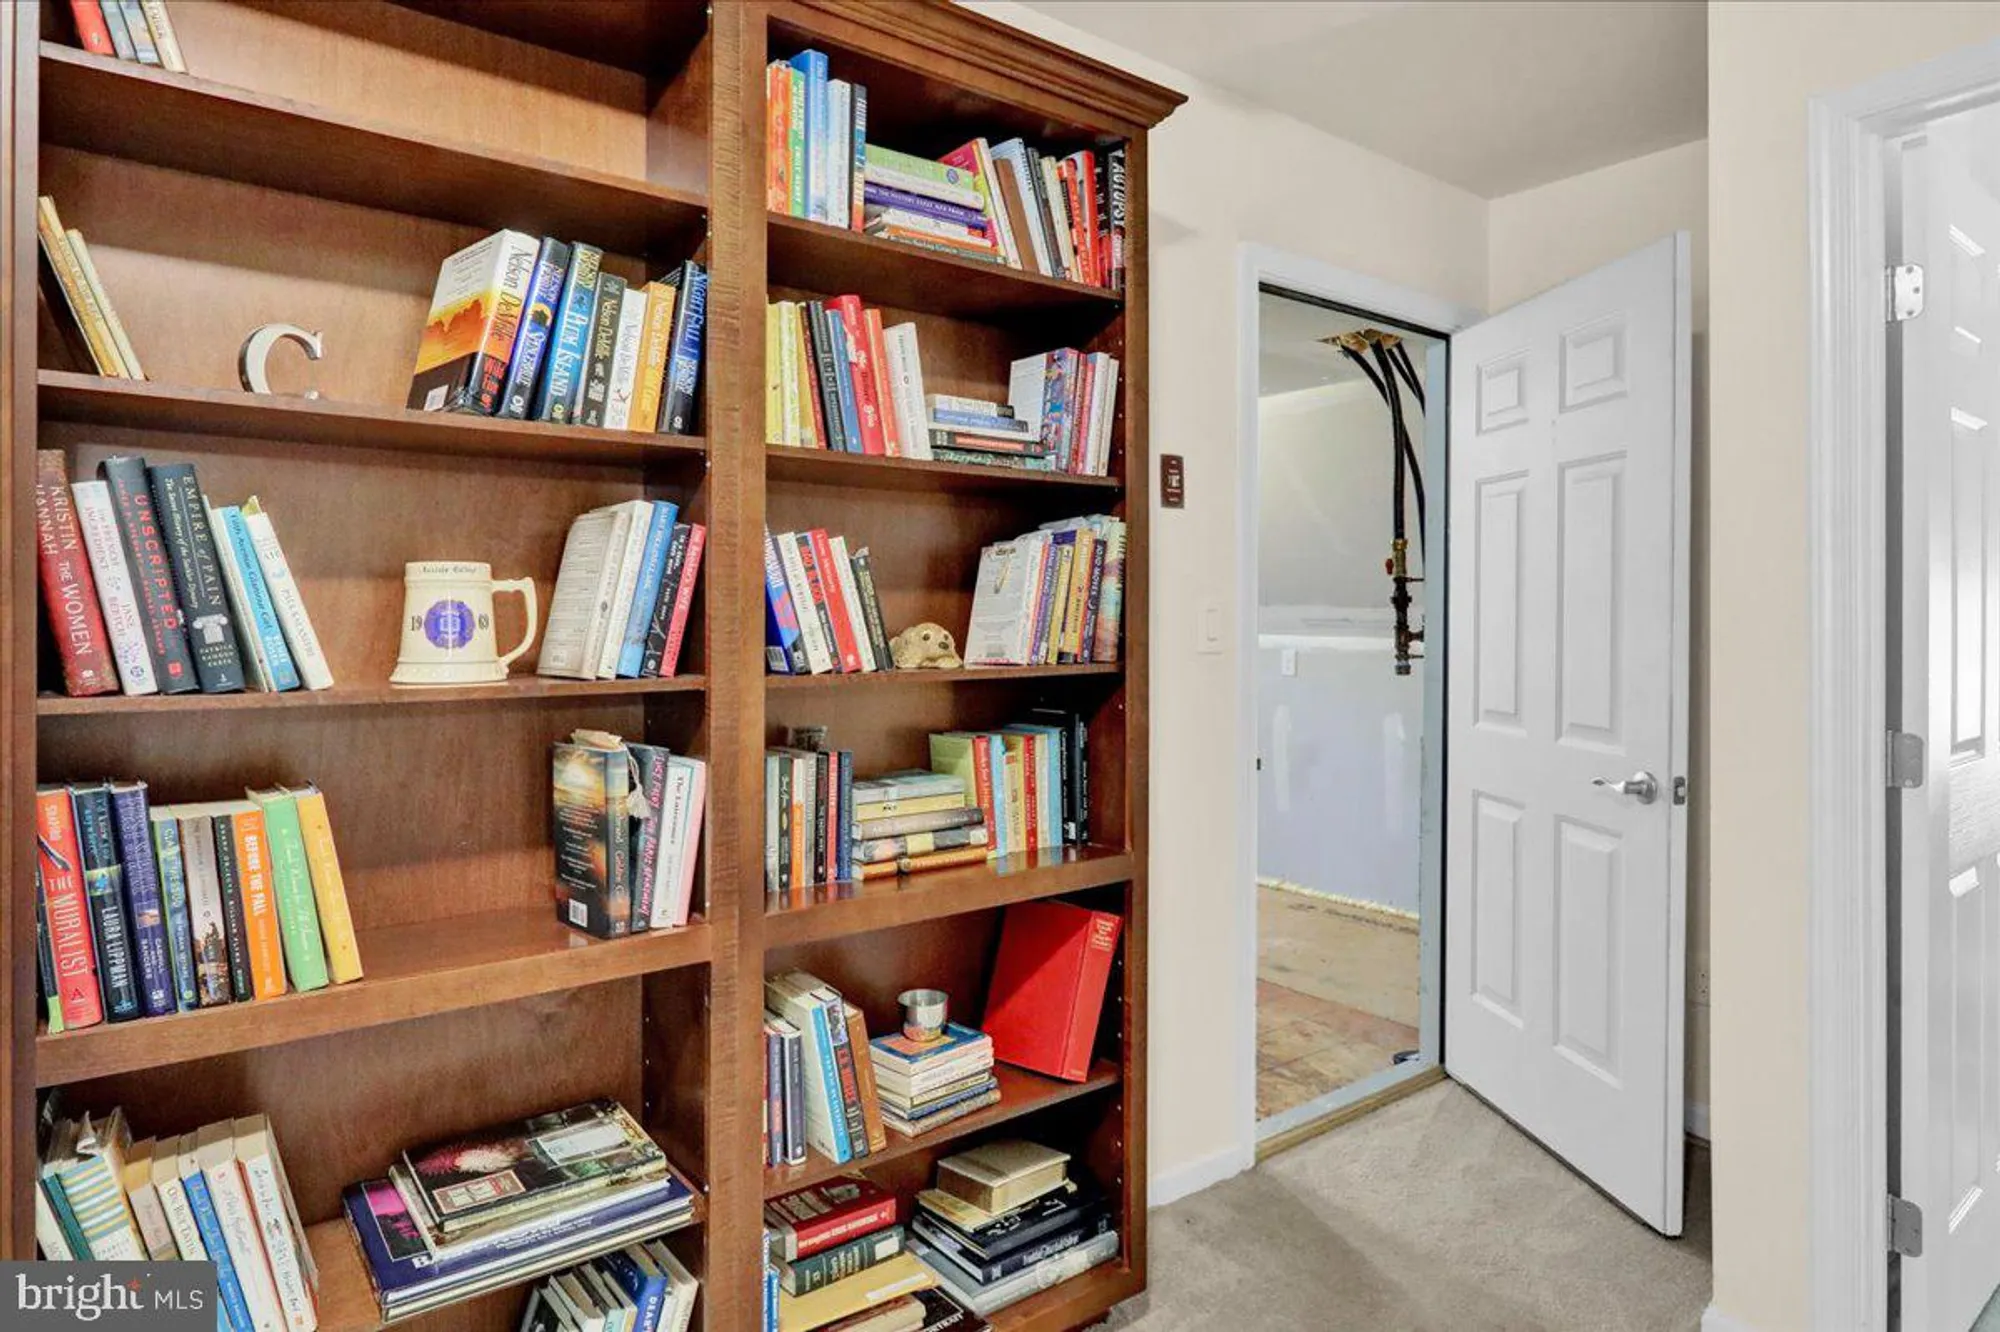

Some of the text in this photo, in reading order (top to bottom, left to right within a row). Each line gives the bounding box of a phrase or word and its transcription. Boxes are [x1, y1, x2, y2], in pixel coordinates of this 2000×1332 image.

[1111, 163, 1125, 225] AUTOPSY
[500, 245, 535, 291] Nelson
[491, 290, 523, 344] DeMille
[598, 298, 619, 327] Nelson
[678, 269, 712, 343] NIGHT FALL
[548, 310, 589, 399] PLUM ISLAND
[163, 476, 174, 490] The
[166, 490, 179, 511] Secret
[49, 483, 77, 550] KRISTIN
[168, 510, 185, 538] History
[179, 473, 222, 607] EMPIRE of PAIN
[130, 492, 181, 632] UNSCRIPTED
[179, 545, 189, 558] the
[184, 582, 200, 609] Dynasty
[1090, 566, 1100, 595] MOYES
[57, 559, 92, 656] THE WOMEN
[411, 615, 423, 631] 19
[642, 834, 657, 862] PARIS
[48, 877, 72, 891] THE
[243, 834, 267, 916] BEFORE THE FALL
[48, 891, 89, 978] MURALIST
[99, 905, 130, 989] LAURA LIPPMAN
